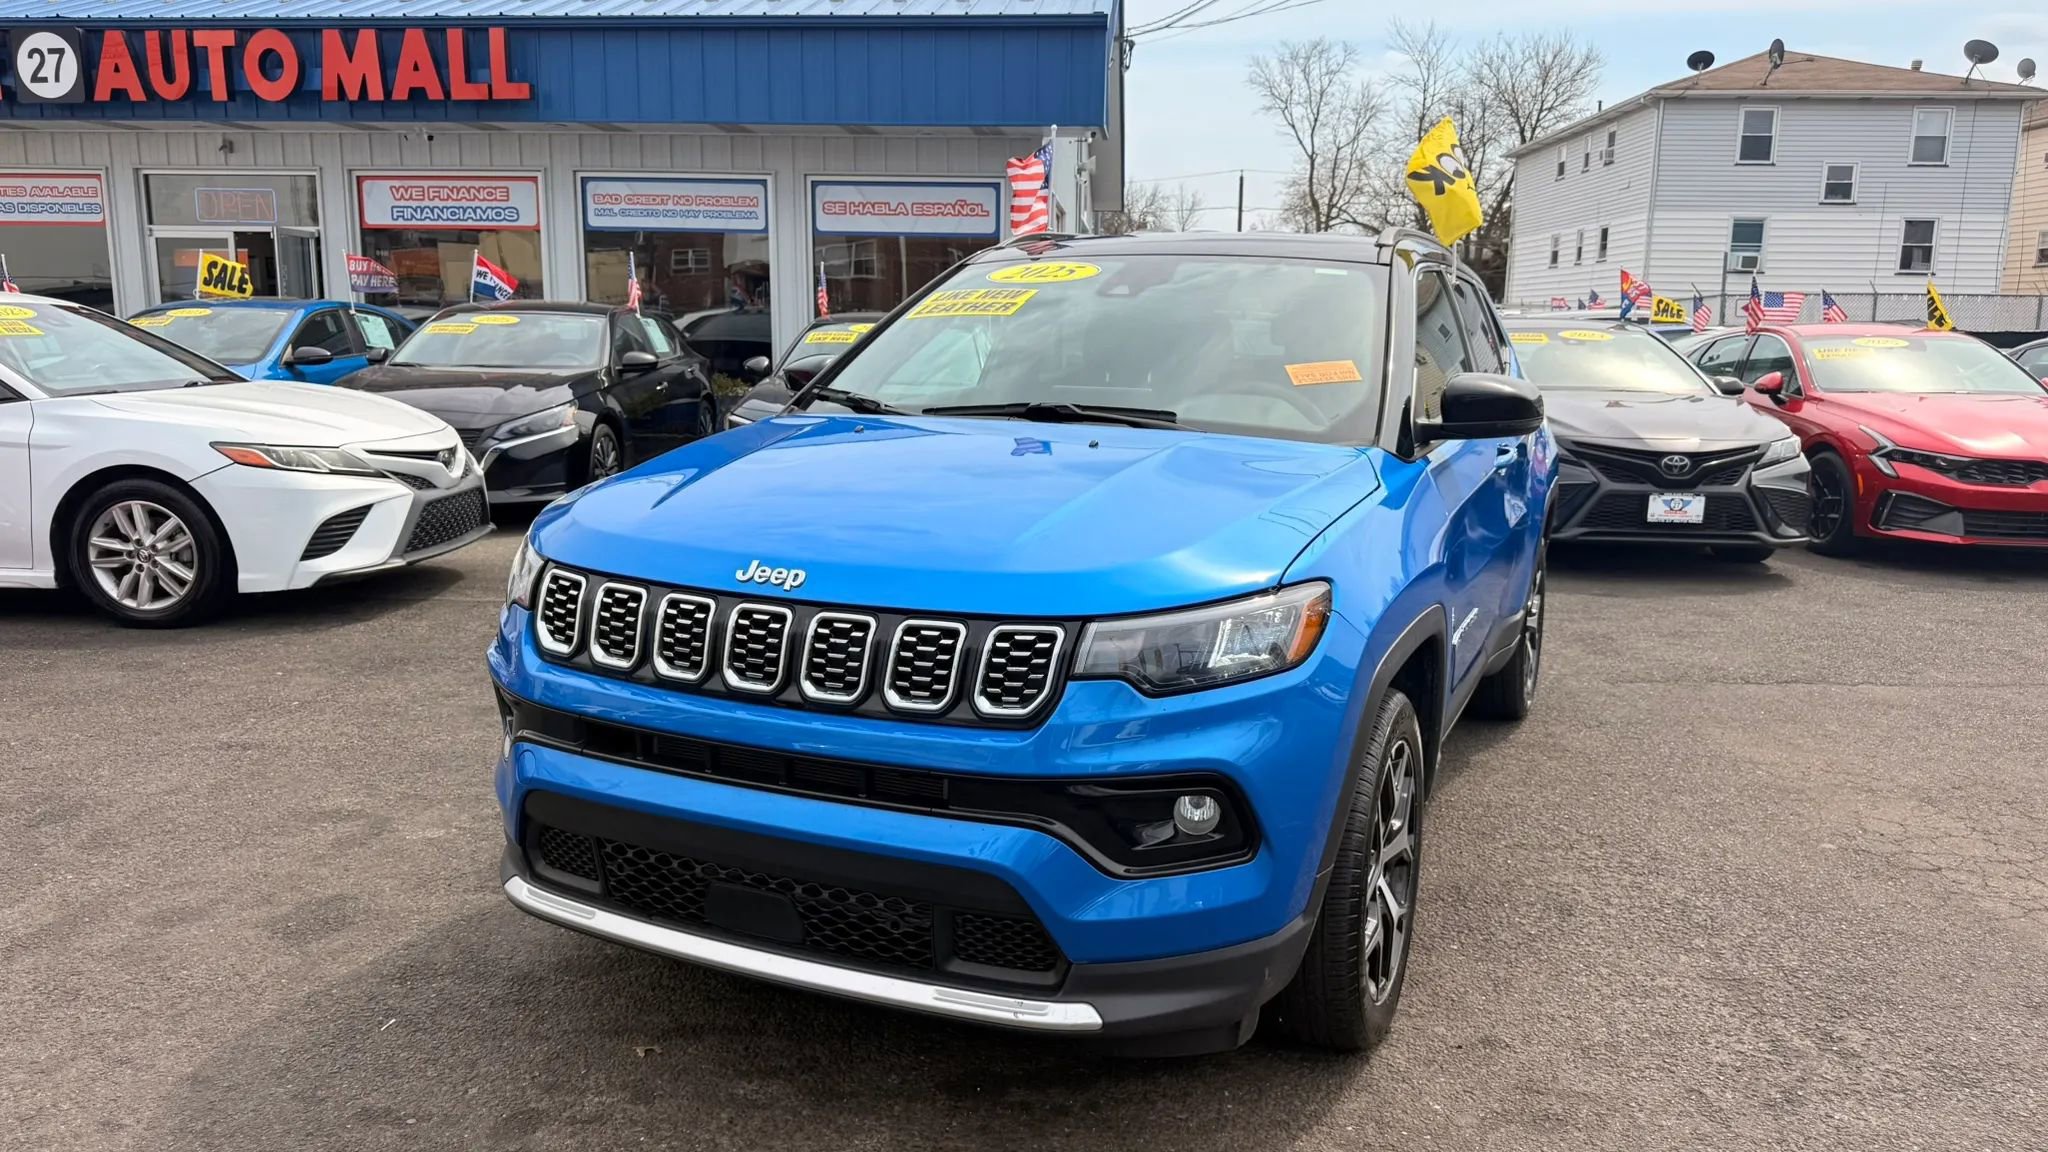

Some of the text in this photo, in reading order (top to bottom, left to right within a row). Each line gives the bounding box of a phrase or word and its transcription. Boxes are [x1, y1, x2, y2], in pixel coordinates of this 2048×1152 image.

[28, 28, 530, 101] 27 AUTO MALL
[30, 186, 98, 197] AVAILABLE
[390, 186, 509, 201] WE FINANCE
[17, 202, 102, 214] DISPONIBLES
[200, 191, 274, 219] OPEN
[593, 194, 758, 208] BAD CREDIT NO PROBLEM
[391, 206, 519, 221] FINANCIAMOS
[594, 208, 758, 220] MAL CREDITO NO HAY PROBLEMA
[823, 200, 989, 217] SE HABLA ESPAÑOL
[348, 260, 368, 271] BUY
[1002, 265, 1087, 280] 2025
[203, 261, 249, 295] SALE
[351, 274, 369, 287] PAY
[476, 269, 489, 281] WE
[930, 288, 1028, 302] LIKE NEW
[917, 301, 1017, 315] LEATHER
[1654, 299, 1684, 319] SALE
[736, 560, 806, 592] Jeep
